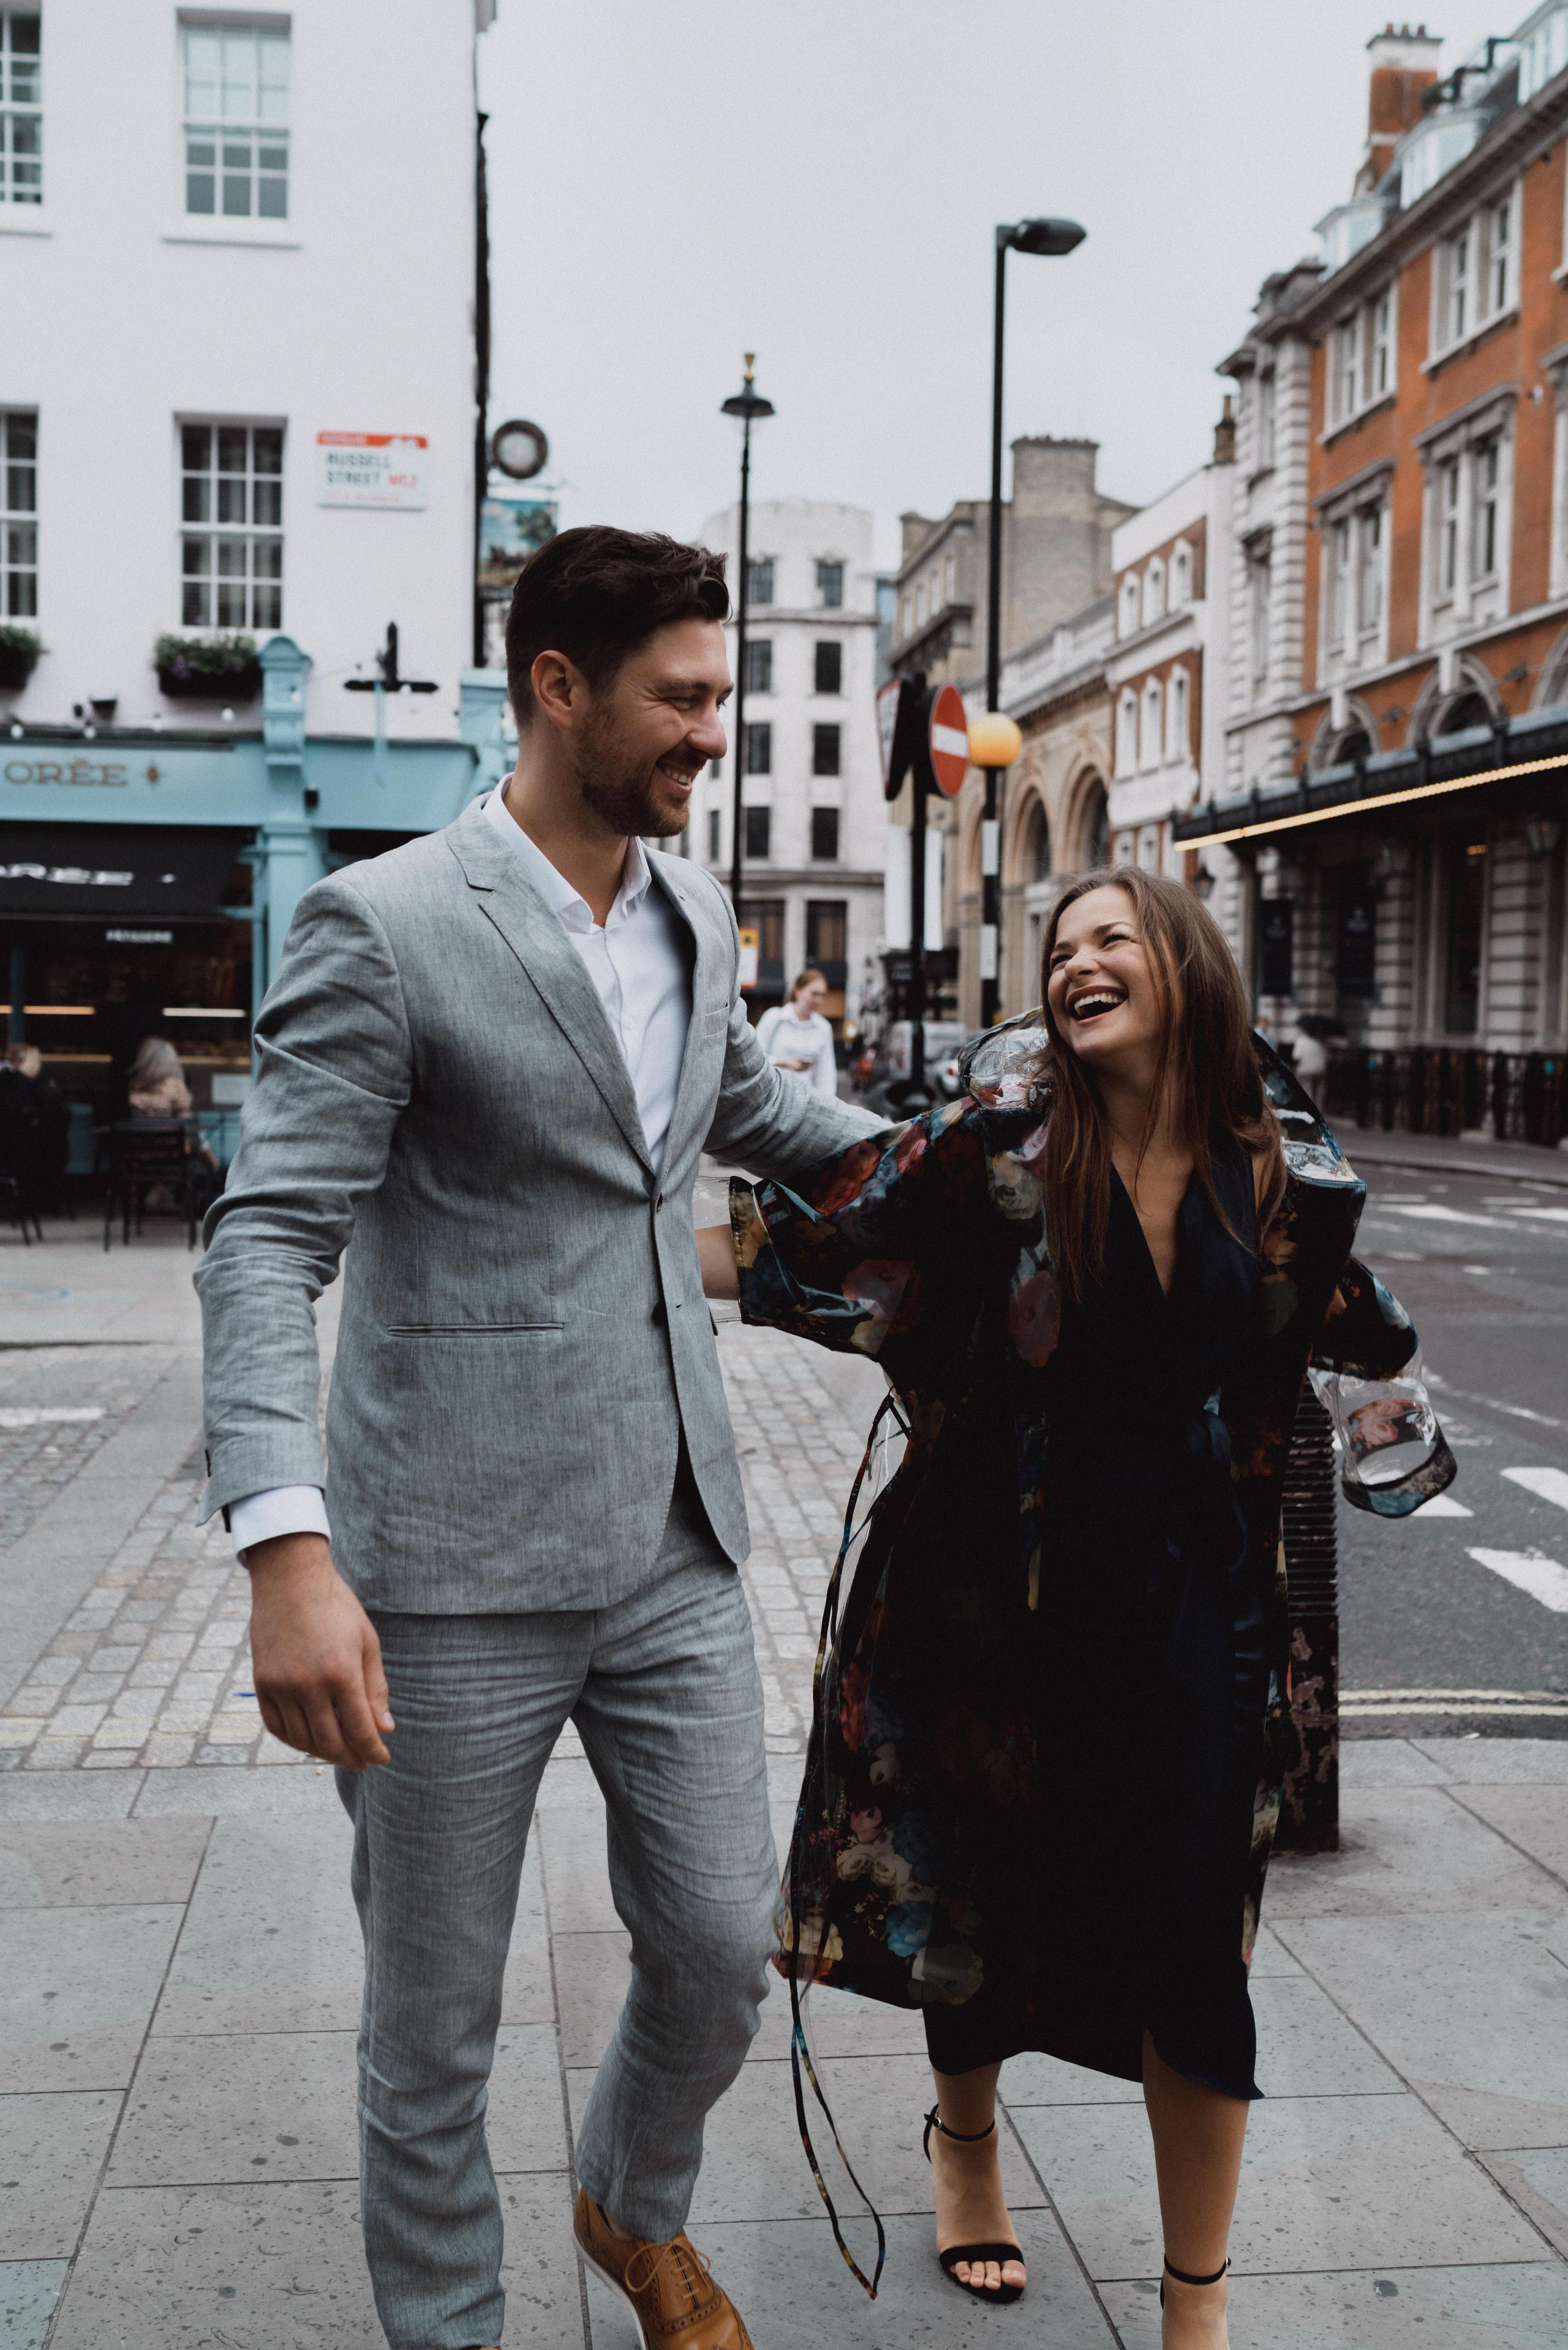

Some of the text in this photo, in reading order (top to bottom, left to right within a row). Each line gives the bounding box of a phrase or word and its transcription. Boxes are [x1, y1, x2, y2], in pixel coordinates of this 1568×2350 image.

[327, 453, 391, 468] RUSSELL
[327, 471, 418, 488] STREET WC2
